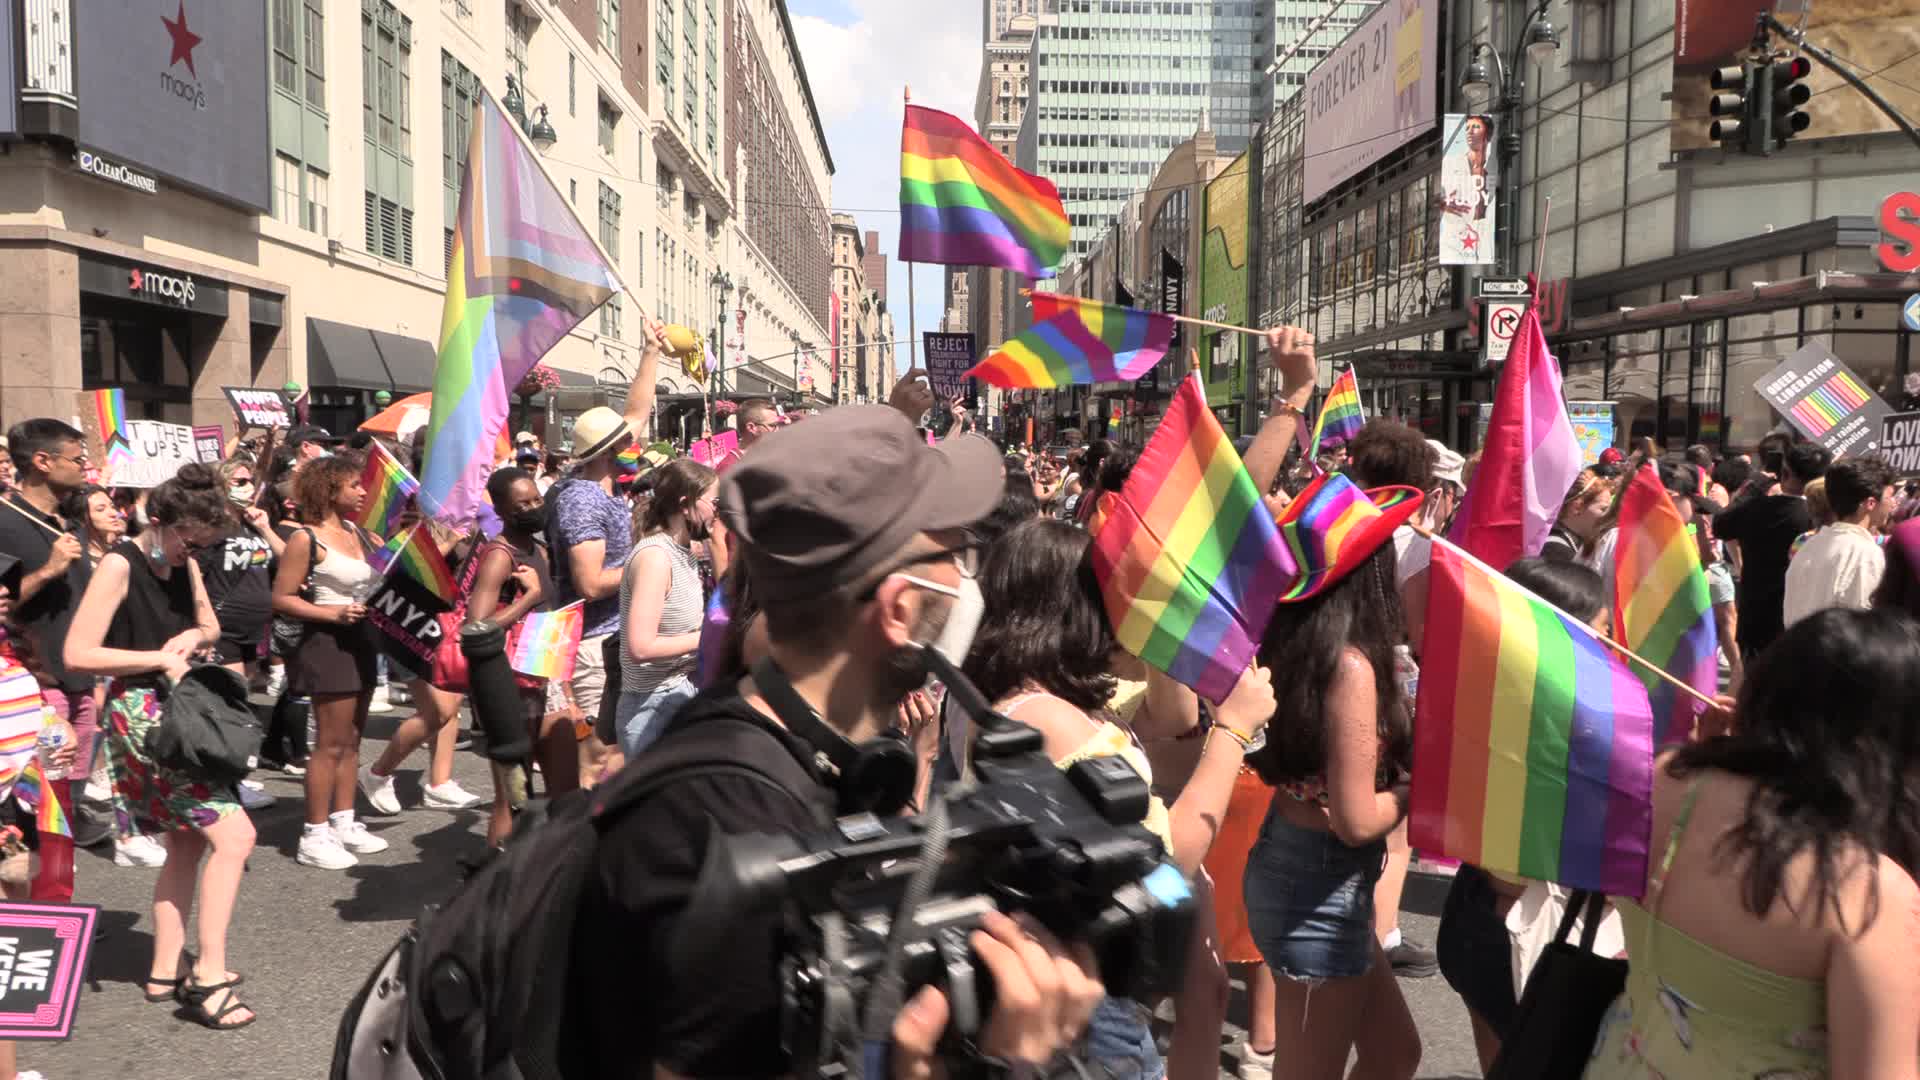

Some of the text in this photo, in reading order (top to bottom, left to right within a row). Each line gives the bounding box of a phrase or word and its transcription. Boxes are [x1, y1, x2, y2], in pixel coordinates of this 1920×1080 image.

[1310, 42, 1366, 125] FOREVER
[1373, 22, 1388, 73] 21
[160, 71, 206, 110] macy's
[145, 271, 196, 304] macy's
[1166, 276, 1178, 312] NAVY
[1487, 282, 1526, 290] ONE WAY
[929, 336, 969, 352] REJECT
[934, 382, 971, 399] NOW!
[1766, 370, 1798, 396] QUEER
[1775, 358, 1836, 404] LIBERATION
[242, 410, 292, 427] PEOPLE
[1836, 415, 1866, 440] rainbow
[151, 423, 189, 444] THE
[11, 949, 55, 991] WE
